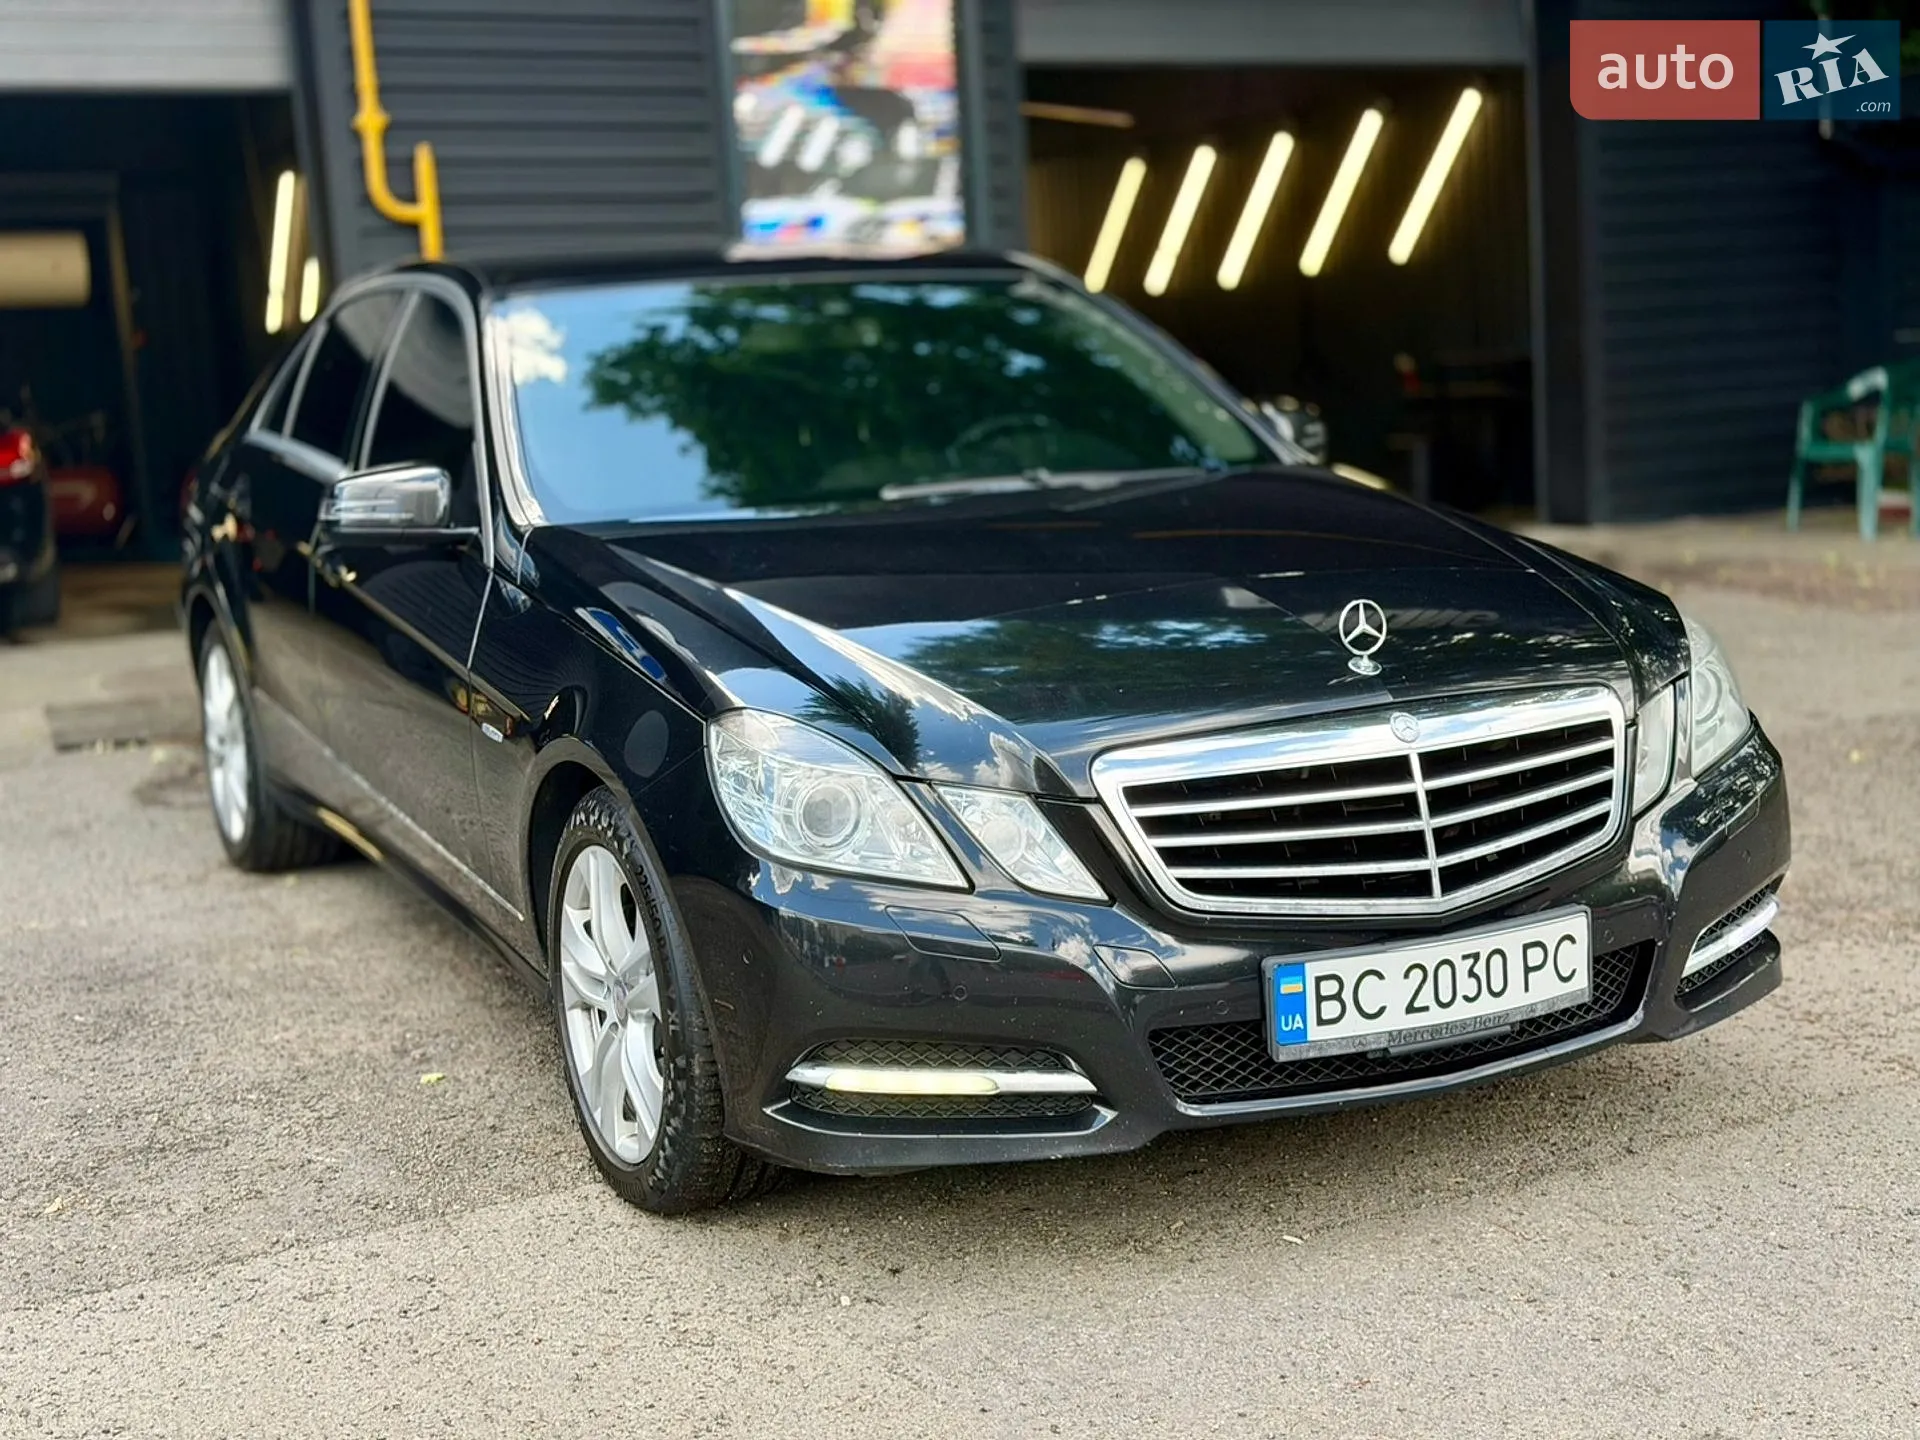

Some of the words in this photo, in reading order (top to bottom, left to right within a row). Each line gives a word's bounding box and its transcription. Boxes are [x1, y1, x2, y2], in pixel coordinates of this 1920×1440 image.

[1313, 968, 1388, 1027] BC
[1402, 948, 1508, 1015] 2030
[1522, 934, 1577, 993] PC
[1280, 1012, 1304, 1032] UA
